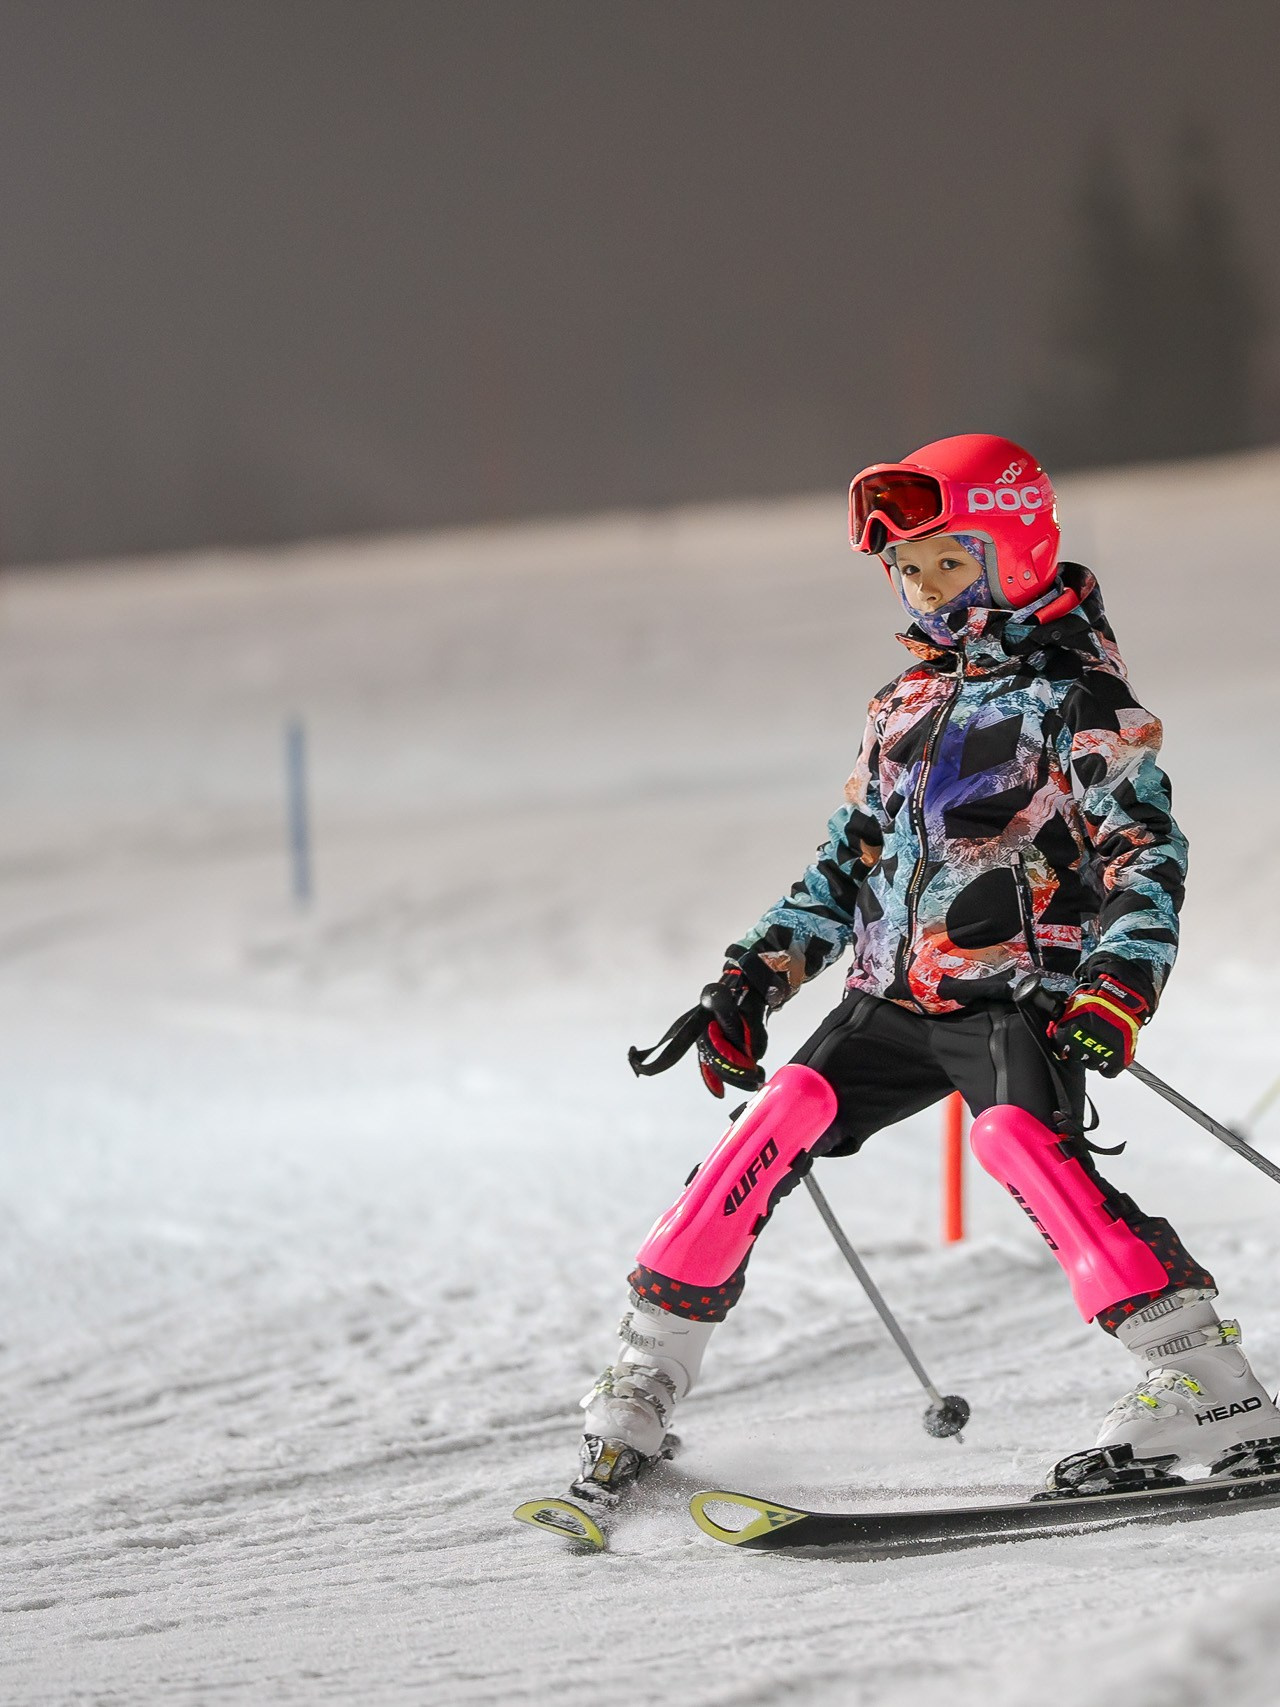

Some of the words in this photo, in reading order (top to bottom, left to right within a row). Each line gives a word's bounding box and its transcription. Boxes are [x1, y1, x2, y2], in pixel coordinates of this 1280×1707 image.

[1073, 1030, 1114, 1057] LEKI
[730, 1136, 779, 1208] UFO
[1194, 1396, 1262, 1426] HEAD
